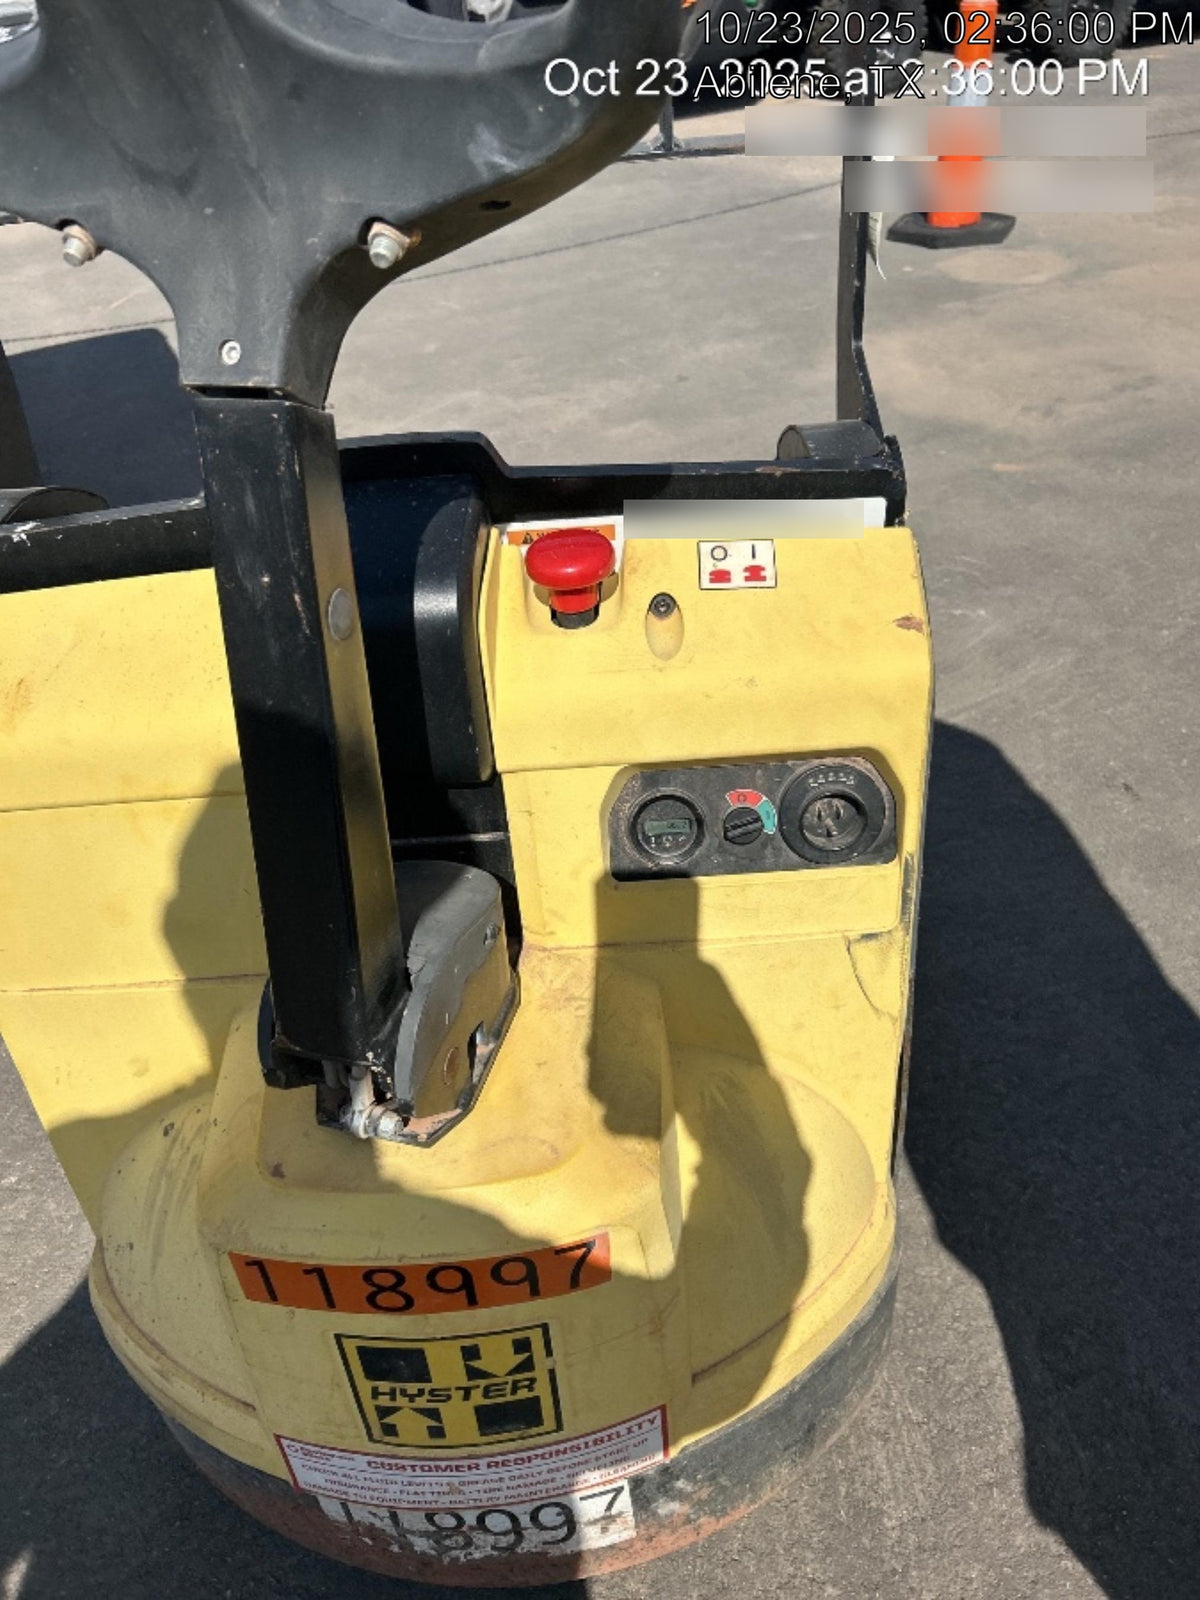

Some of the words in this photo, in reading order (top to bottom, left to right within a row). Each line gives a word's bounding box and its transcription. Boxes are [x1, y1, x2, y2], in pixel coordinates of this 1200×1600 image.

[244, 1240, 596, 1314] 118997
[370, 1376, 538, 1404] HYSTER
[366, 1459, 481, 1474] CUSTOMER
[487, 1415, 658, 1470] RESPONSIBILITY
